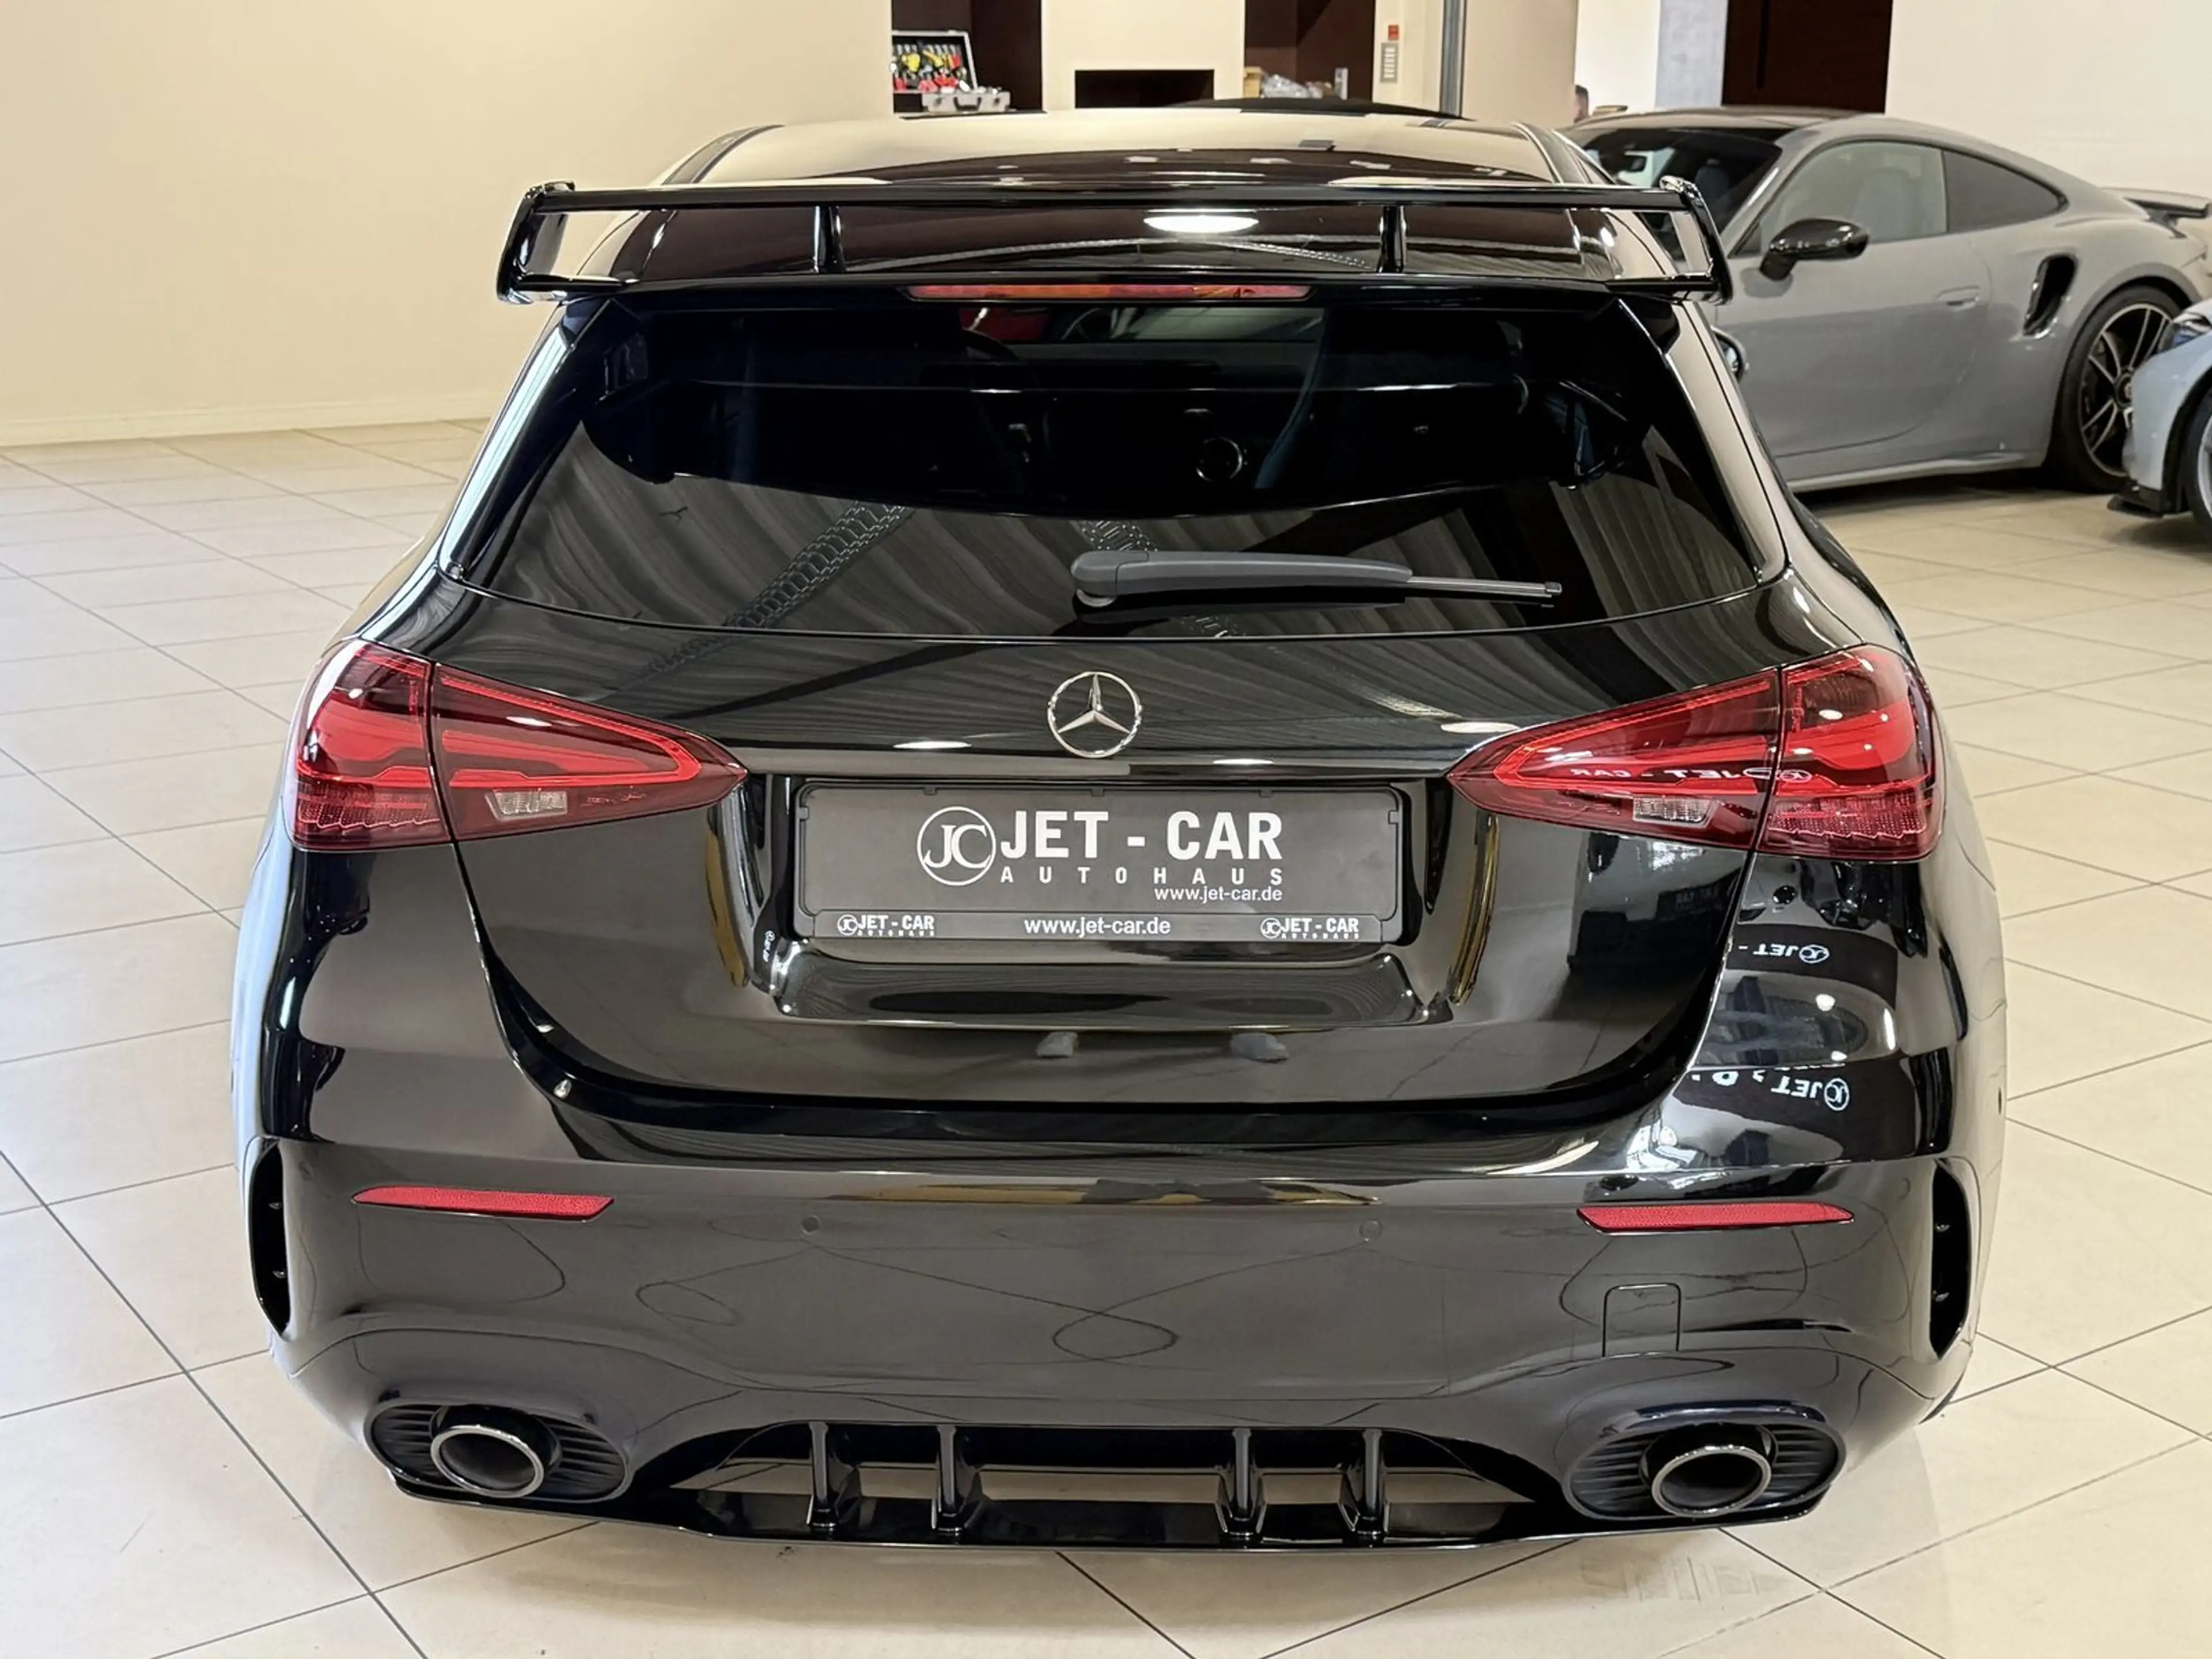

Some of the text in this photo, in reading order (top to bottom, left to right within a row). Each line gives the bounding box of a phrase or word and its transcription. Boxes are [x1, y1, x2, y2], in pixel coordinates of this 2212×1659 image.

[1000, 810, 1109, 859] JET
[1127, 836, 1146, 847] -
[1166, 810, 1283, 861] CAR
[1000, 865, 1283, 886] AUTOHAUS
[1153, 885, 1283, 904] www.jet-car.de
[857, 914, 889, 930] JET
[902, 914, 935, 930] CAR
[1023, 916, 1171, 939] www.jet-car.de
[1281, 917, 1313, 933] JET
[1325, 917, 1359, 933] CAR
[1753, 943, 1799, 957] JET
